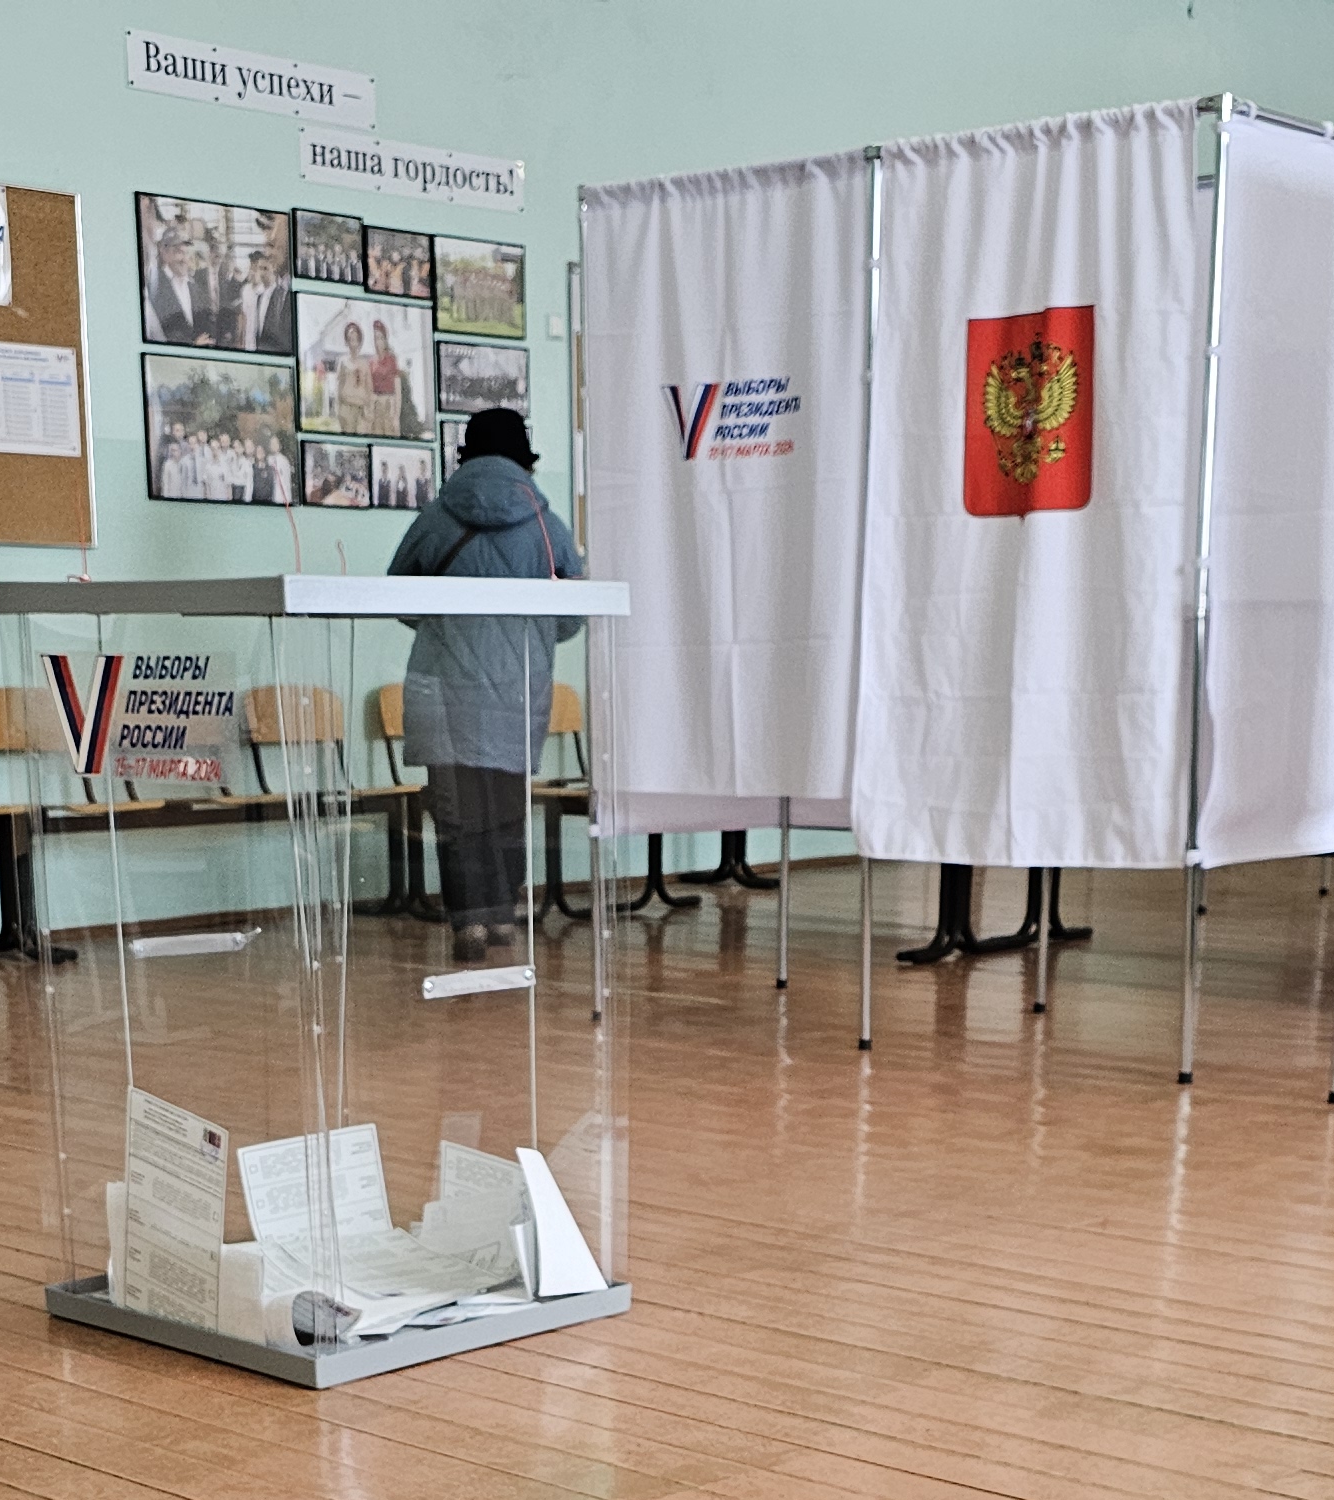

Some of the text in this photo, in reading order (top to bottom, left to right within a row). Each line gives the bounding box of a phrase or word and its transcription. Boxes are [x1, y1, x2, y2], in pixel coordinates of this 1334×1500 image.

[142, 40, 229, 87] Ваши
[235, 66, 336, 107] успехи
[309, 141, 516, 196] наша гордость!
[724, 376, 791, 397] ВЫБОРЫ
[720, 396, 802, 420] ПРЕЗИДЕНТ
[713, 422, 771, 441] РОССИИ
[132, 655, 210, 680] ВЫБОРЫ
[124, 690, 235, 719] ПРЕЗИДЕНТА
[118, 724, 187, 750] РОССИИ
[147, 757, 189, 780] МАРТА
[191, 757, 223, 782] 2024
